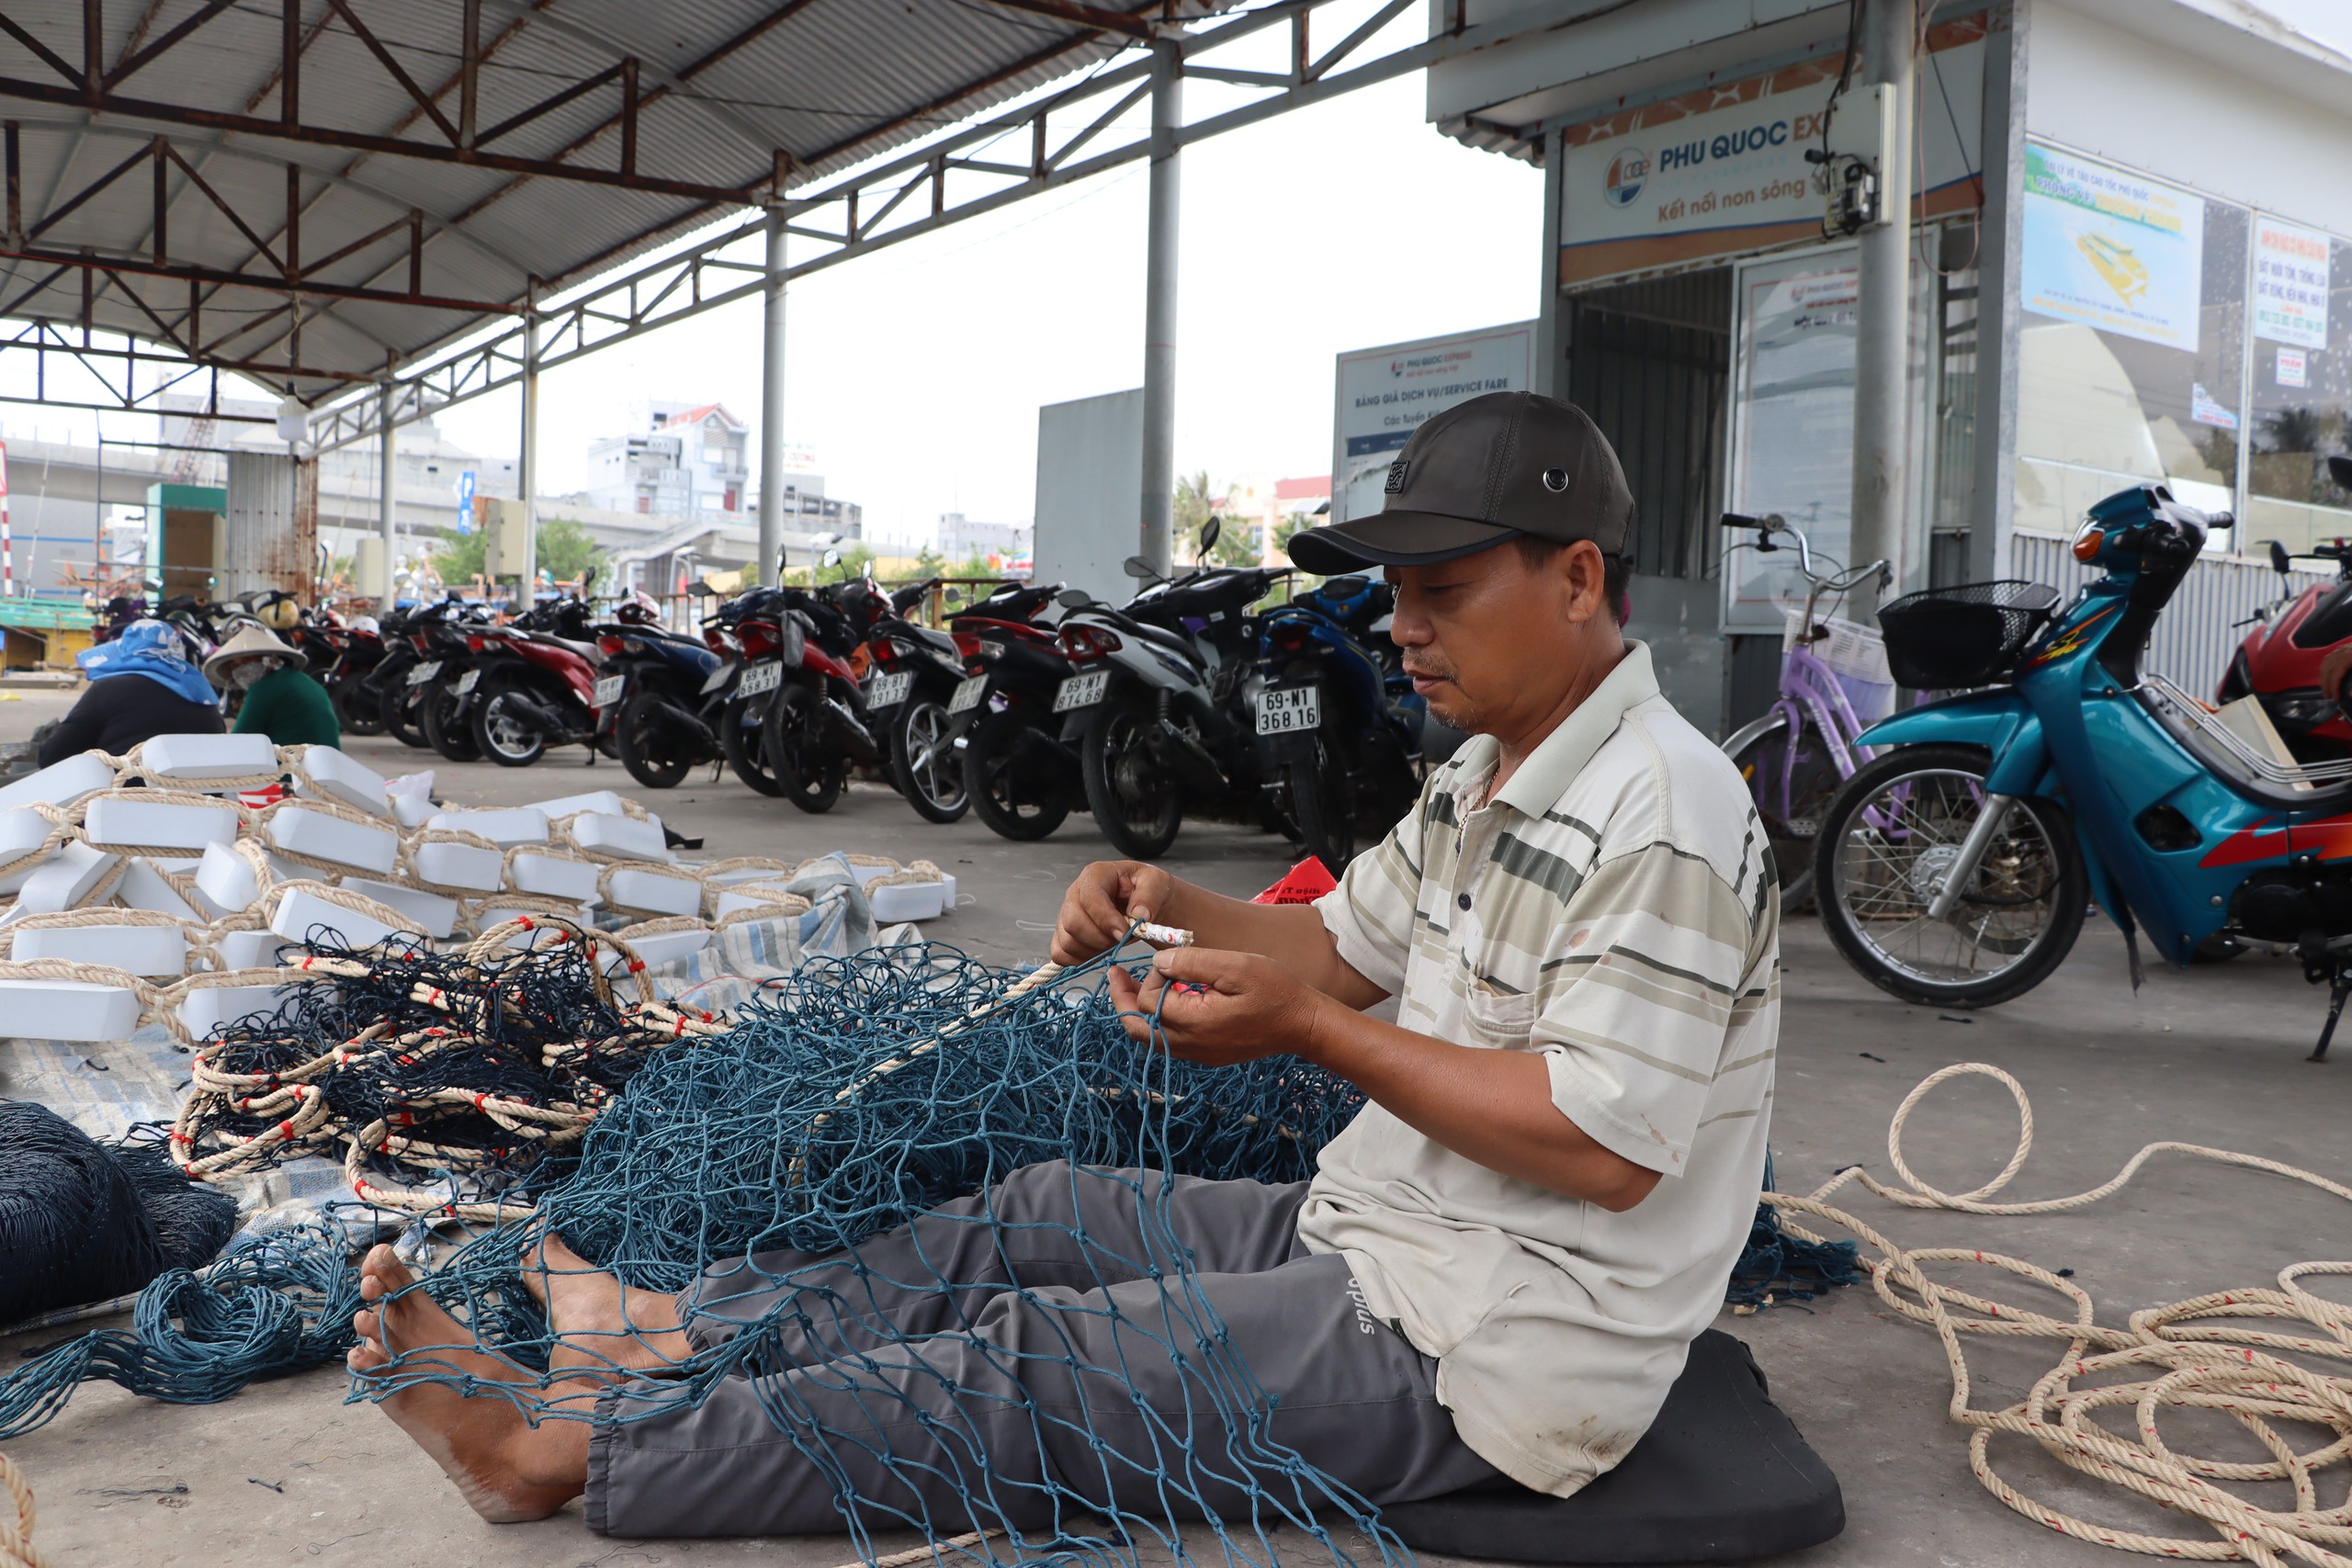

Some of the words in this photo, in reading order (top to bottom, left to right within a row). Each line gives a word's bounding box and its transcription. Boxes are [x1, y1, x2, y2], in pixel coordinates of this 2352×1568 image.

[1659, 140, 1706, 173] PHU
[1711, 120, 1788, 159] QUOC
[1658, 197, 1685, 222] Kết
[1690, 190, 1716, 216] nối
[1723, 190, 1755, 213] non
[1761, 178, 1806, 201] sông
[1485, 377, 1509, 389] FARE
[1066, 673, 1101, 694] 69-N1
[1266, 688, 1307, 710] 69-N1
[1261, 707, 1316, 730] 368.16
